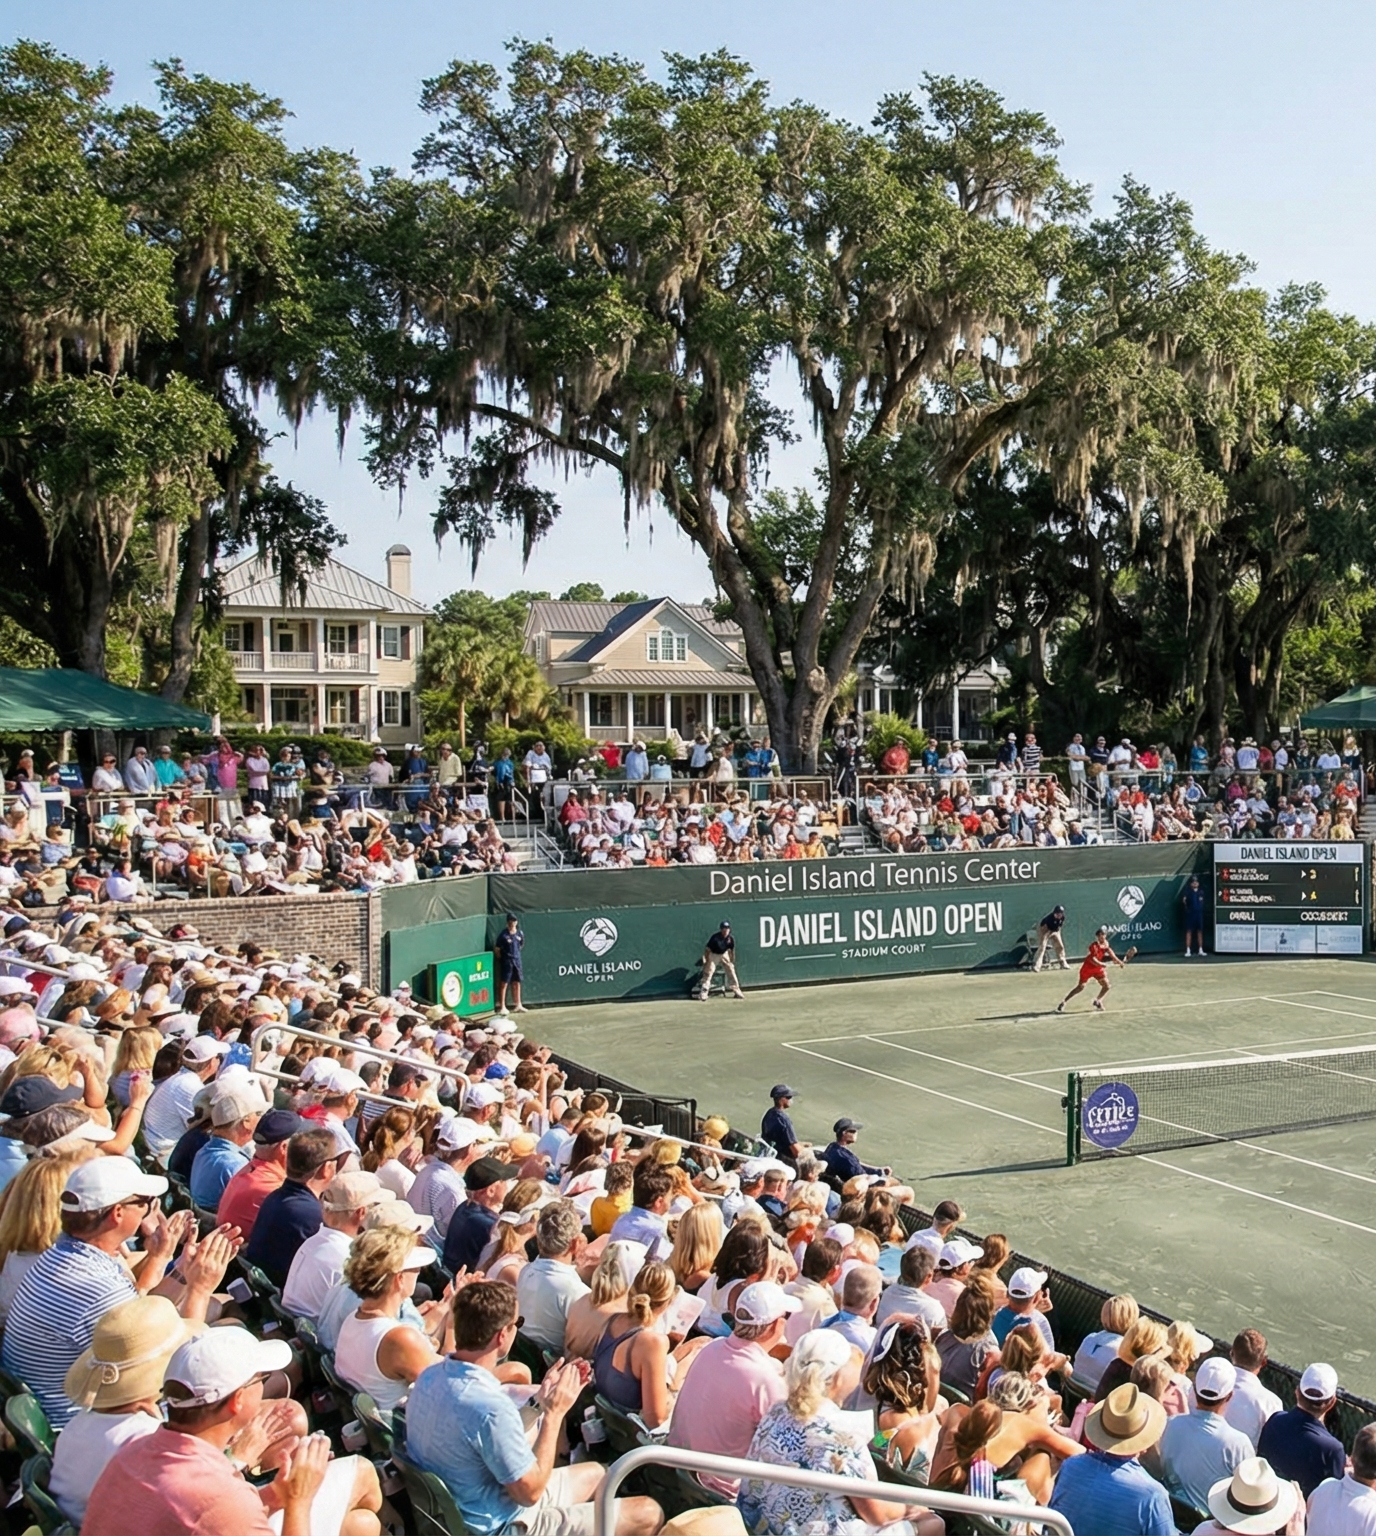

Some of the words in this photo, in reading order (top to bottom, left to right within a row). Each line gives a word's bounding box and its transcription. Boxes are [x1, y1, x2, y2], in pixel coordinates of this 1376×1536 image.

[1241, 847, 1273, 860] DANIEL
[1276, 847, 1309, 860] ISLAND
[710, 866, 793, 896] Daniel
[802, 863, 875, 891] Island
[881, 861, 958, 886] Tennis
[964, 858, 1041, 882] Center
[759, 912, 847, 948] DANIEL
[854, 906, 937, 942] ISLAND
[944, 901, 1003, 935] OPEN
[841, 946, 889, 959] STADIUM
[891, 943, 926, 956] COURT
[558, 963, 599, 976] DANIEL
[586, 974, 614, 983] OPEN
